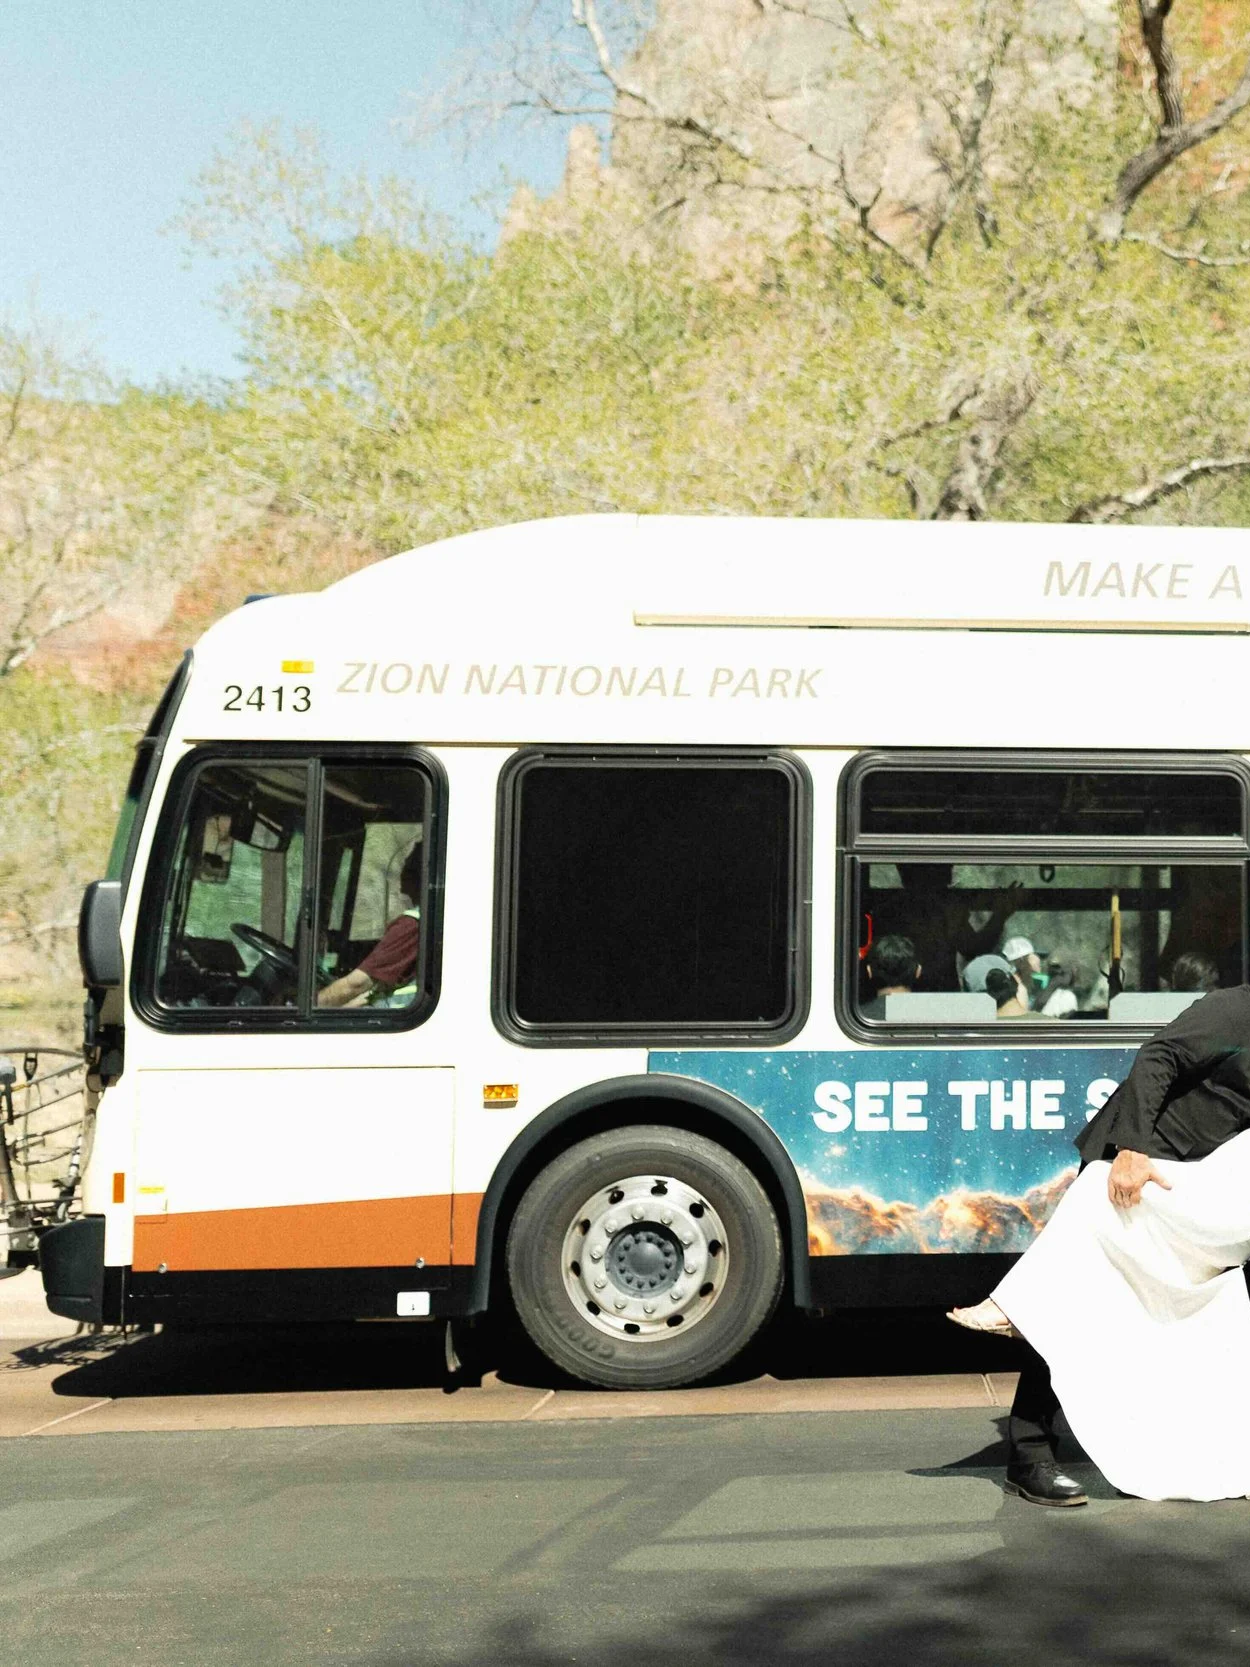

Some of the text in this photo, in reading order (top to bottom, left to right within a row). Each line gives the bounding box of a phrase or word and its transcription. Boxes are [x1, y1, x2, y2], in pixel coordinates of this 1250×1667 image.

[1044, 561, 1193, 599] MAKE
[1209, 565, 1243, 600] A
[222, 684, 312, 713] 2413
[336, 661, 823, 699] ZION NATIONAL PARK
[812, 1079, 929, 1133] SEE
[947, 1079, 1066, 1131] THE
